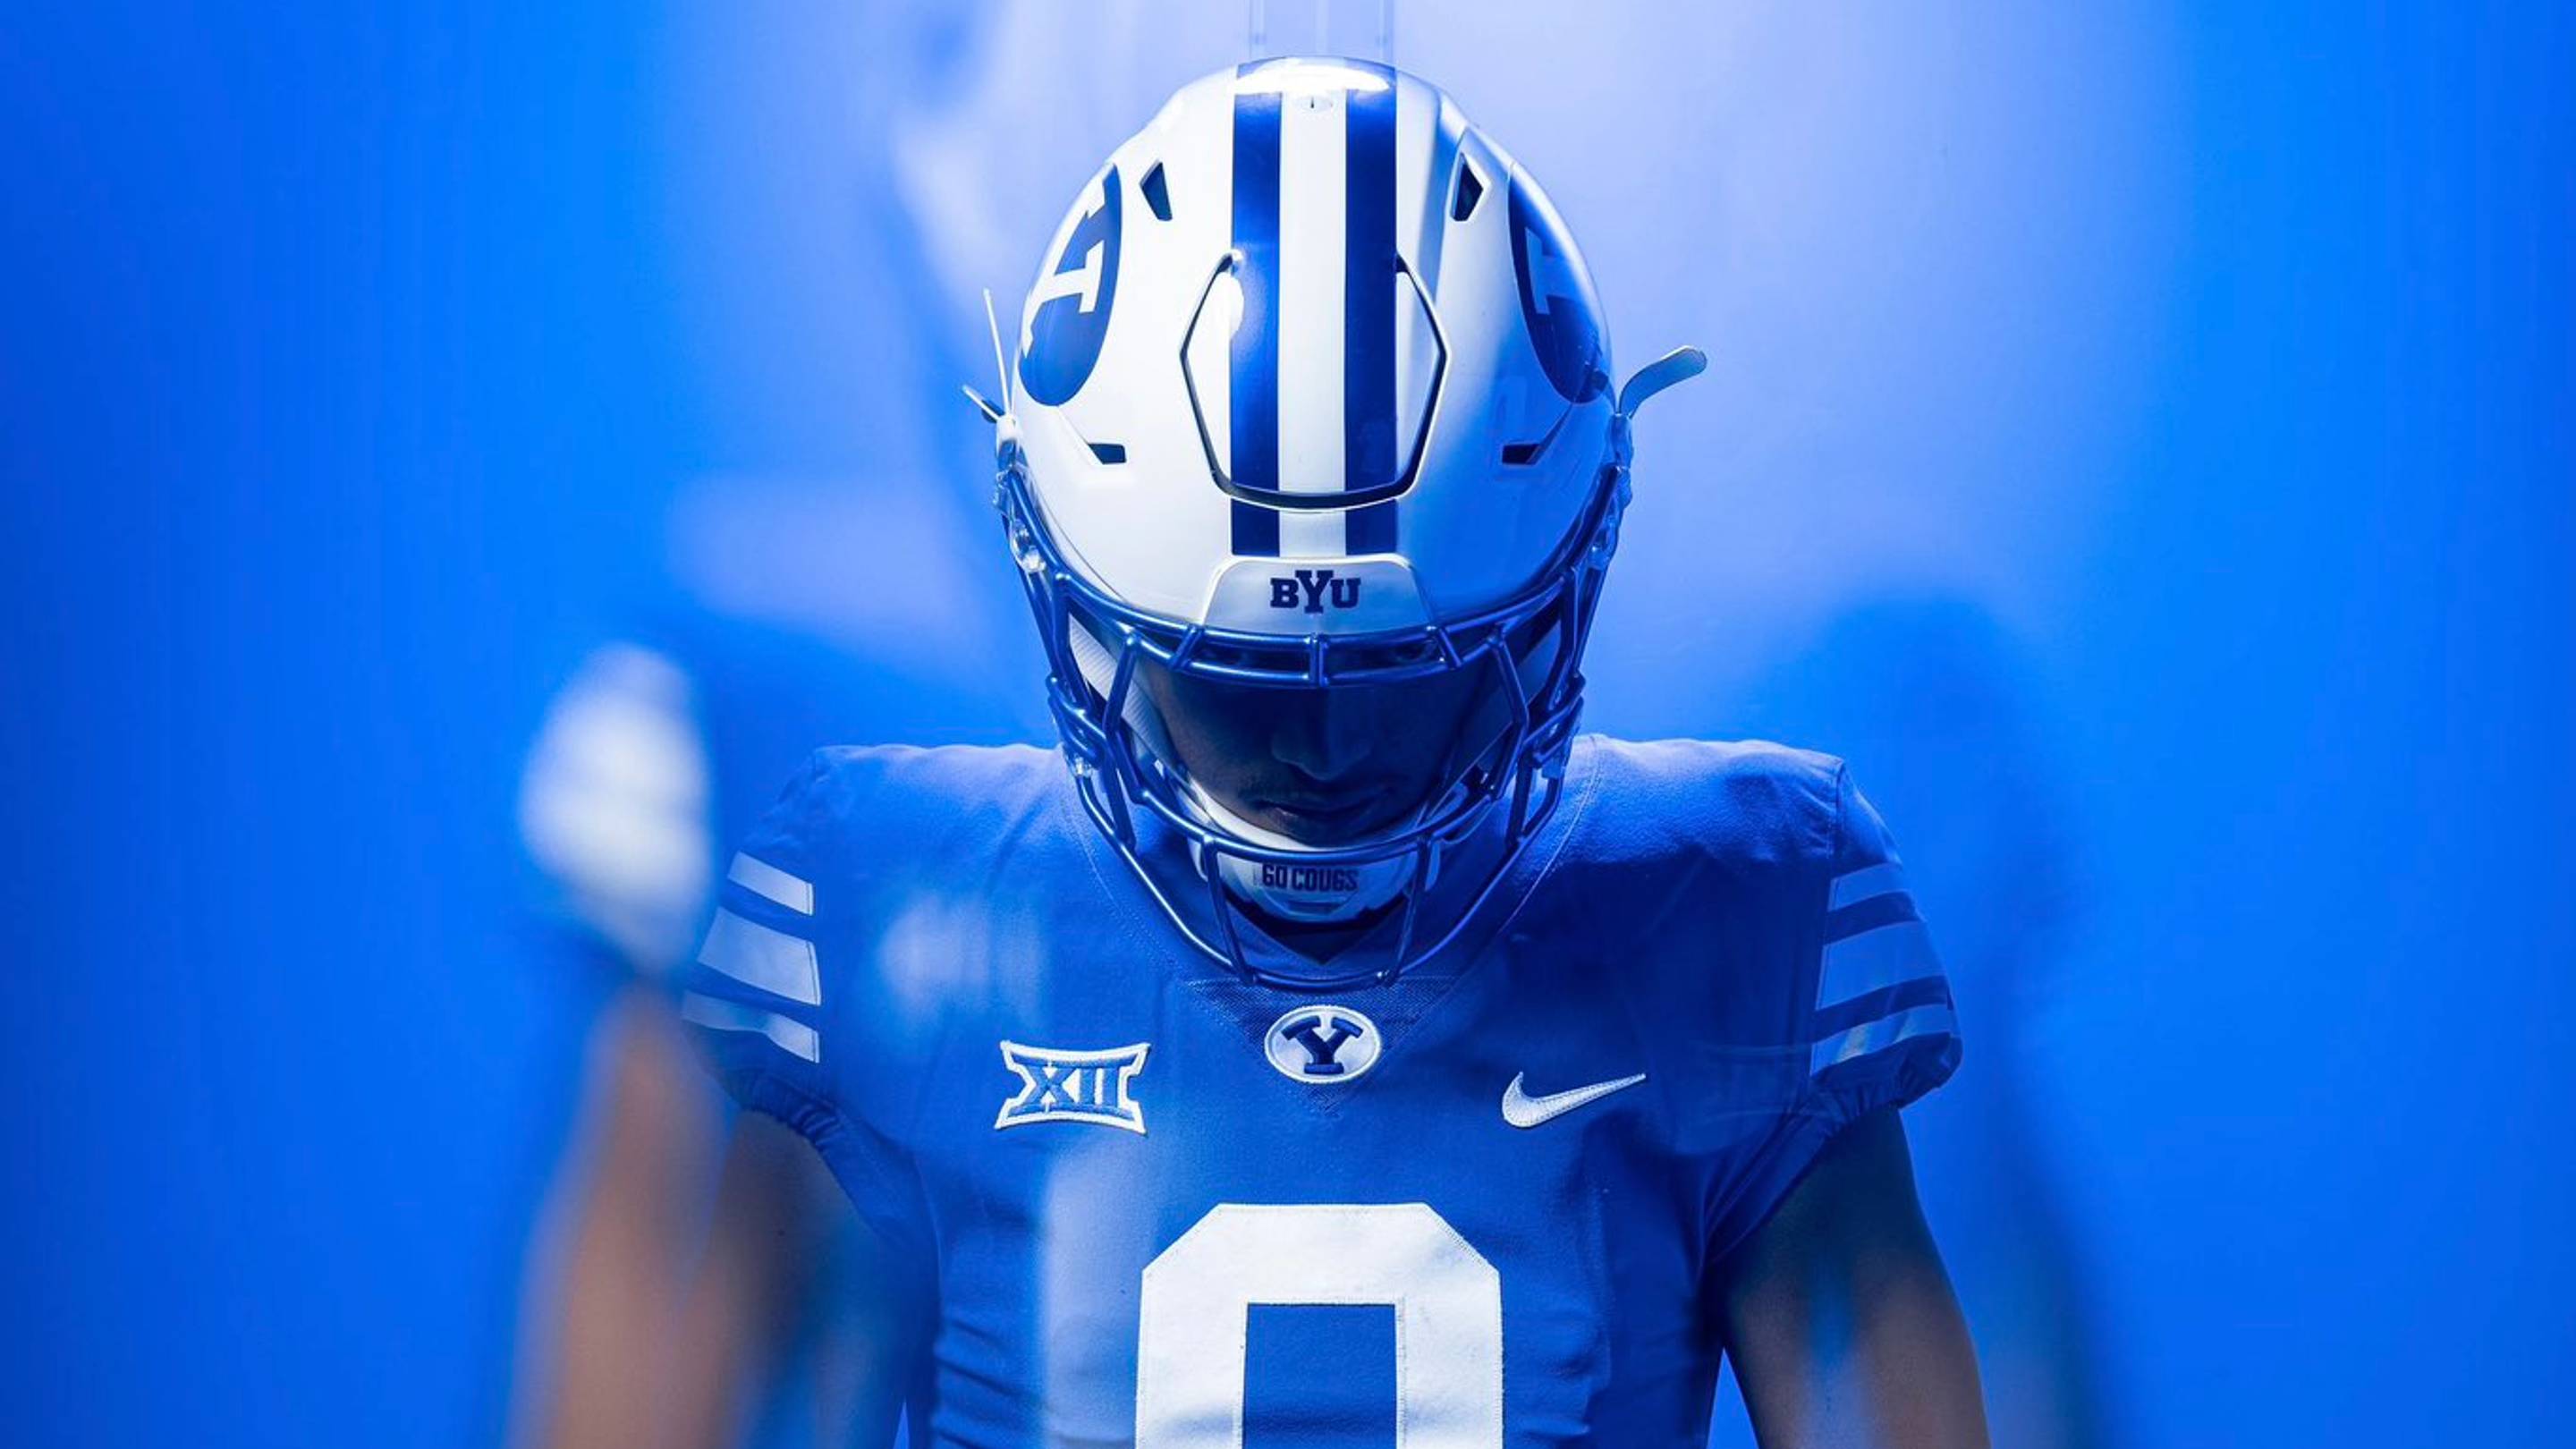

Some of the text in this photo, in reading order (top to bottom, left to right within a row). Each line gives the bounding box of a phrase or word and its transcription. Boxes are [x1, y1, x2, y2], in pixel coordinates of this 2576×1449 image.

[1270, 570, 1361, 614] BYU
[1262, 863, 1360, 892] GO COUGS
[1281, 1015, 1364, 1074] Y
[1005, 1051, 1139, 1123] XII
